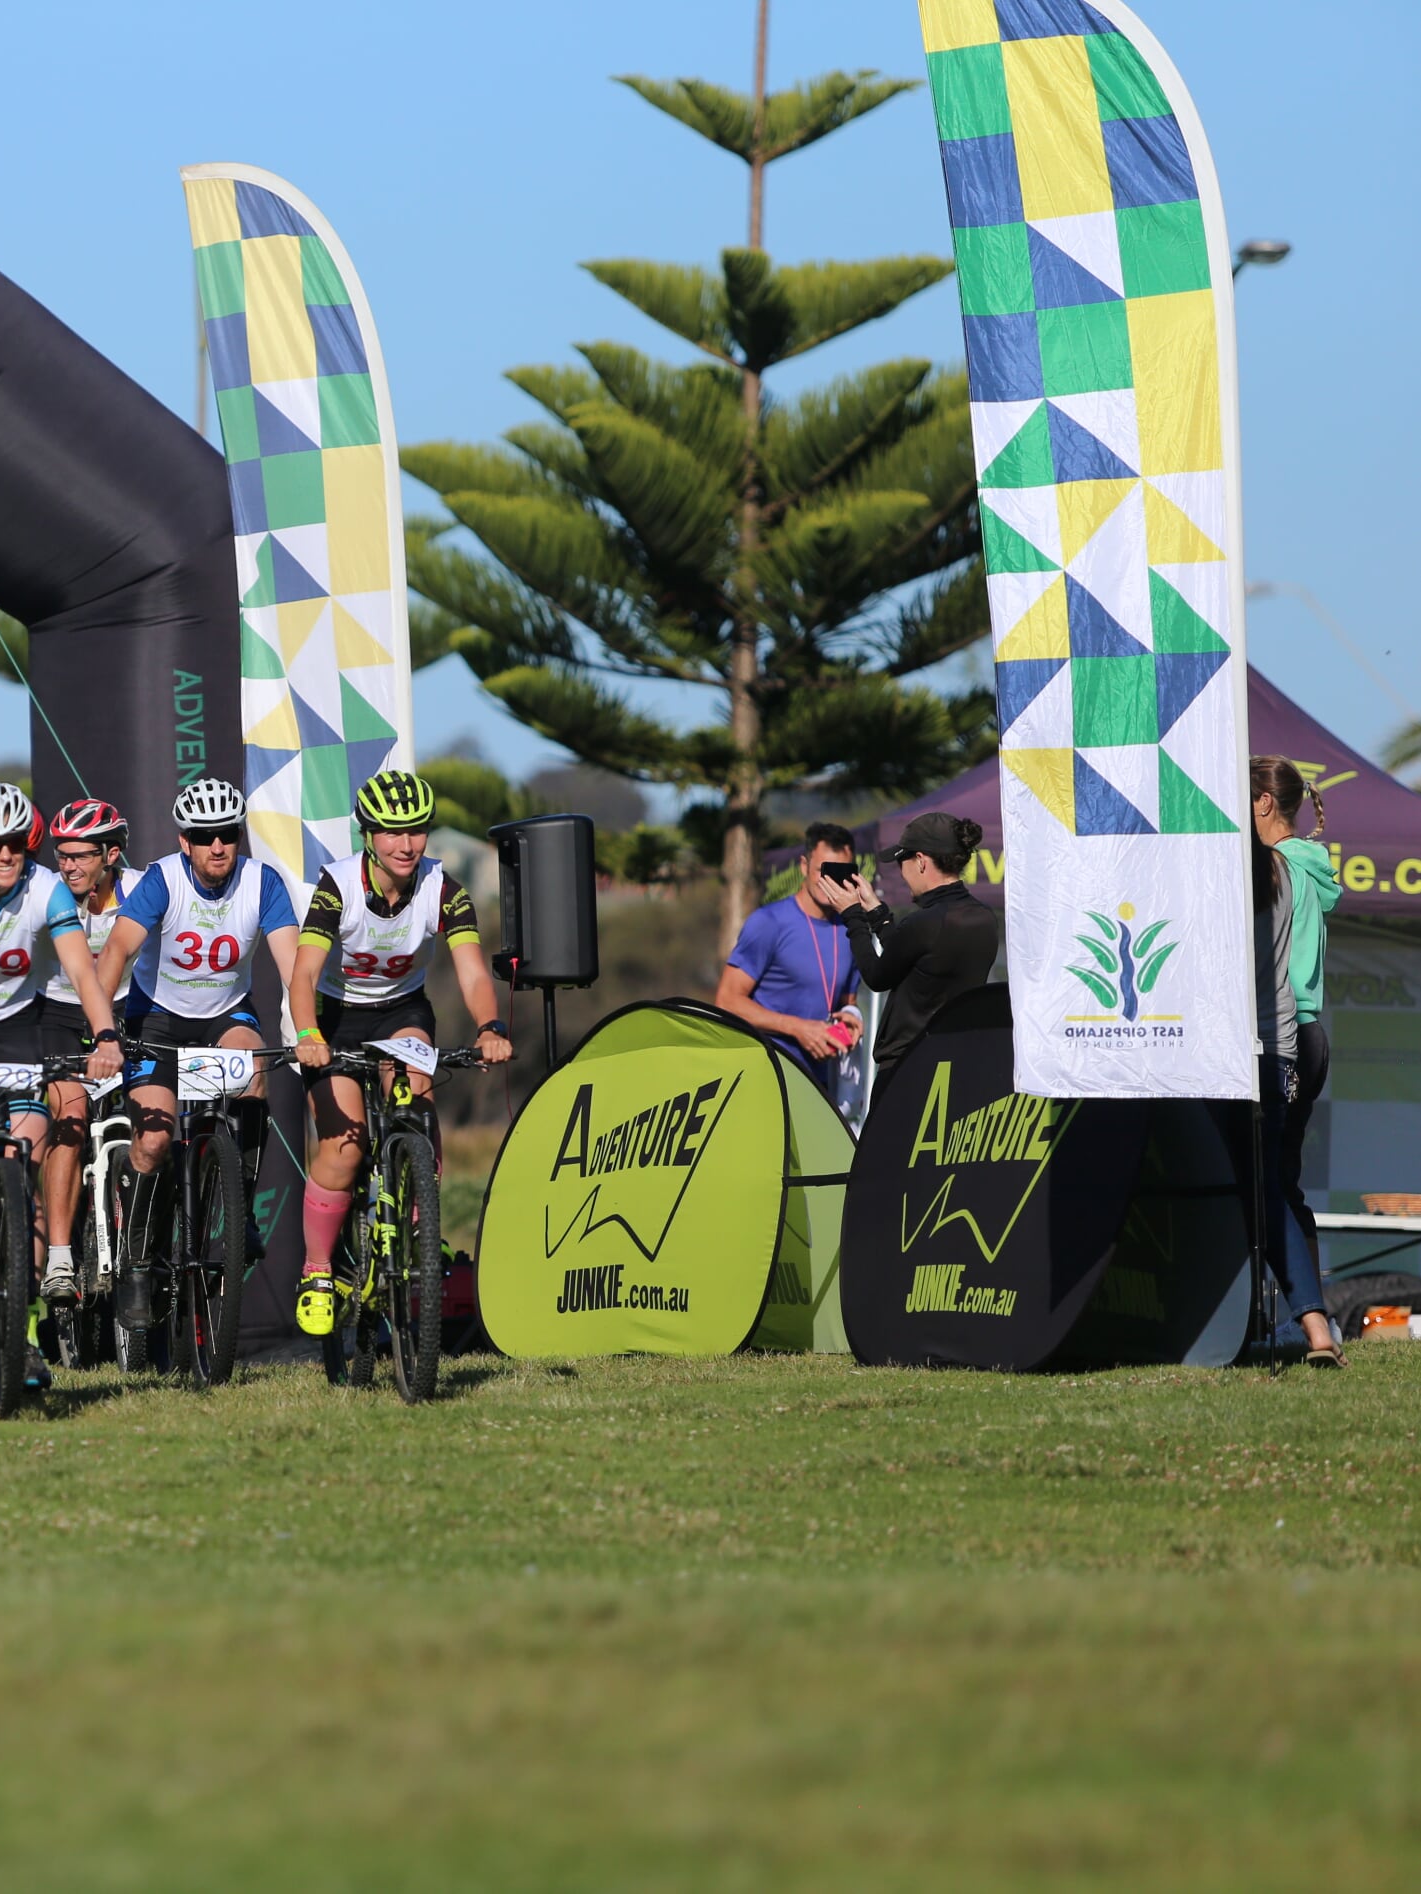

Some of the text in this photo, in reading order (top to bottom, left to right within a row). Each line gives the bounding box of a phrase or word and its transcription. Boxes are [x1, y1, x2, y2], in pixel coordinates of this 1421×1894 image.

[171, 931, 240, 972] 30
[343, 952, 414, 979] 38
[212, 1055, 245, 1081] 30
[397, 1037, 429, 1057] 38
[550, 1077, 722, 1182] ADVENTURE
[908, 1061, 1065, 1168] ADVENTURE
[556, 1264, 689, 1314] JUNKIE.com.au
[905, 1264, 1017, 1317] JUNKIE.com.au
